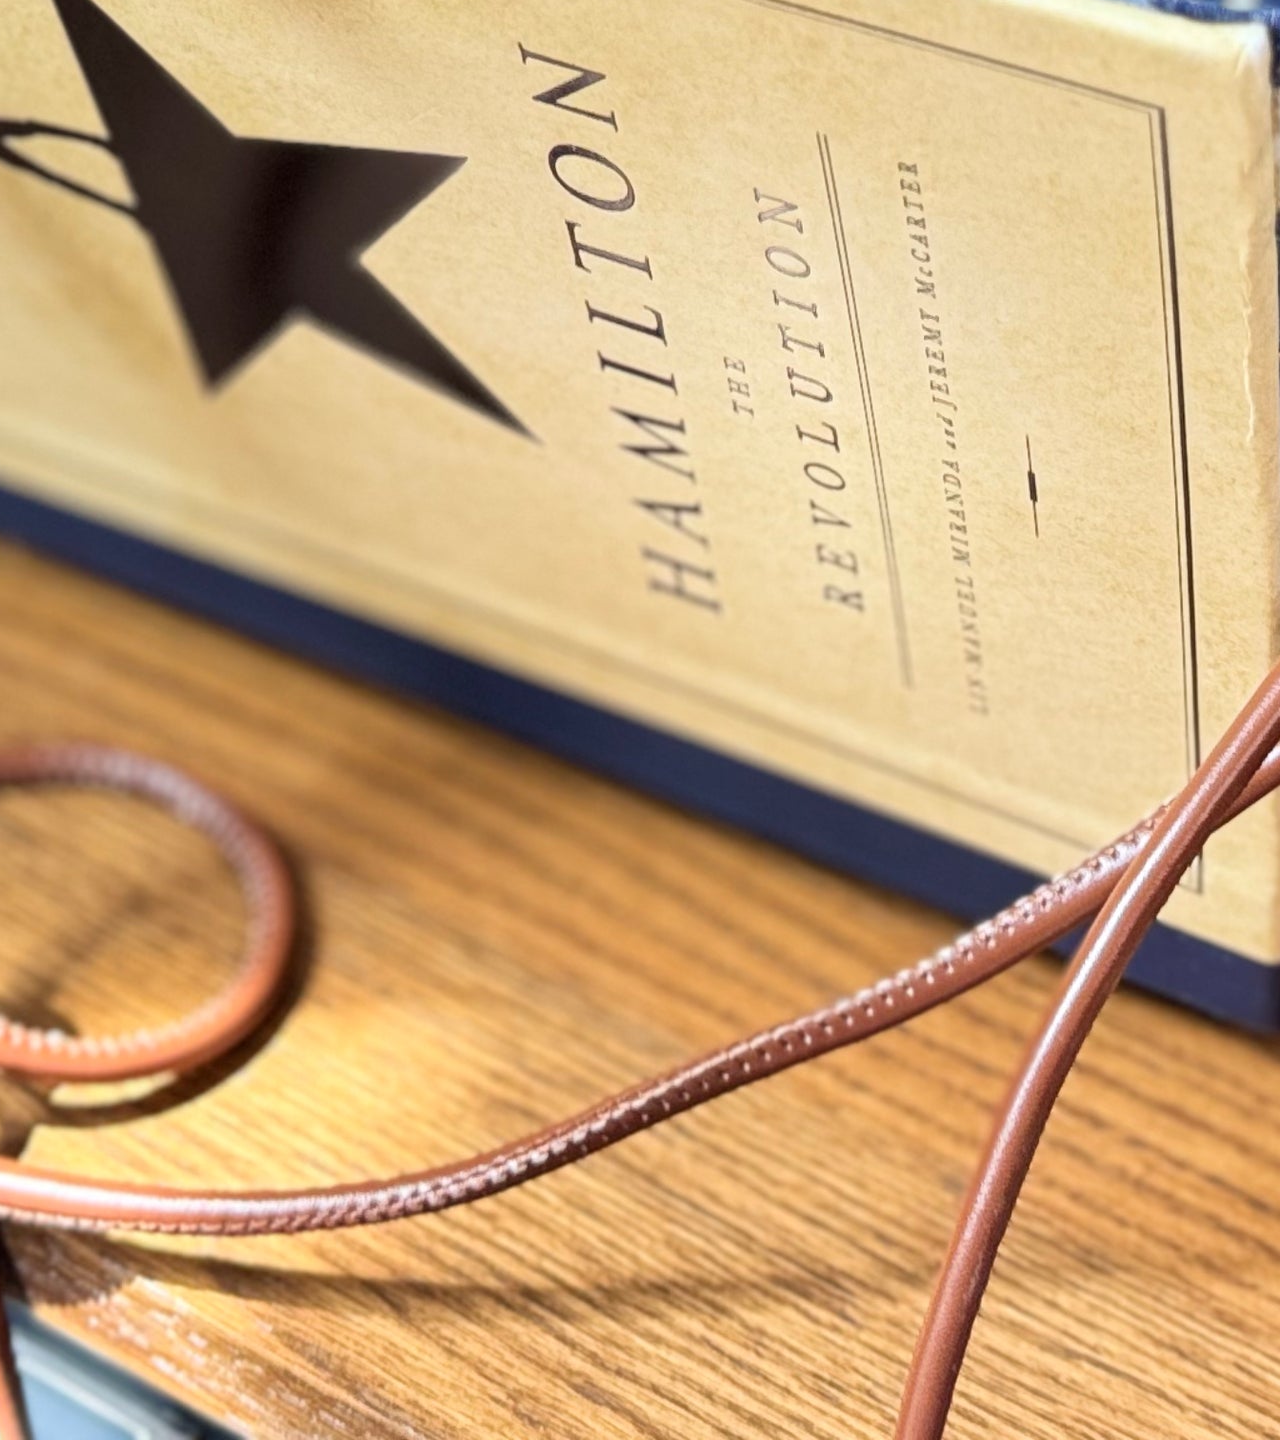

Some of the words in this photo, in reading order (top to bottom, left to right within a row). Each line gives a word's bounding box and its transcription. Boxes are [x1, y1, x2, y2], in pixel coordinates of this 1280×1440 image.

[897, 161, 937, 299] McCARTER
[518, 41, 722, 618] HAMILTON
[723, 356, 755, 419] THE
[919, 308, 958, 412] JEREMY
[752, 187, 865, 613] REVOLUTION
[941, 459, 972, 569] MIRANDA
